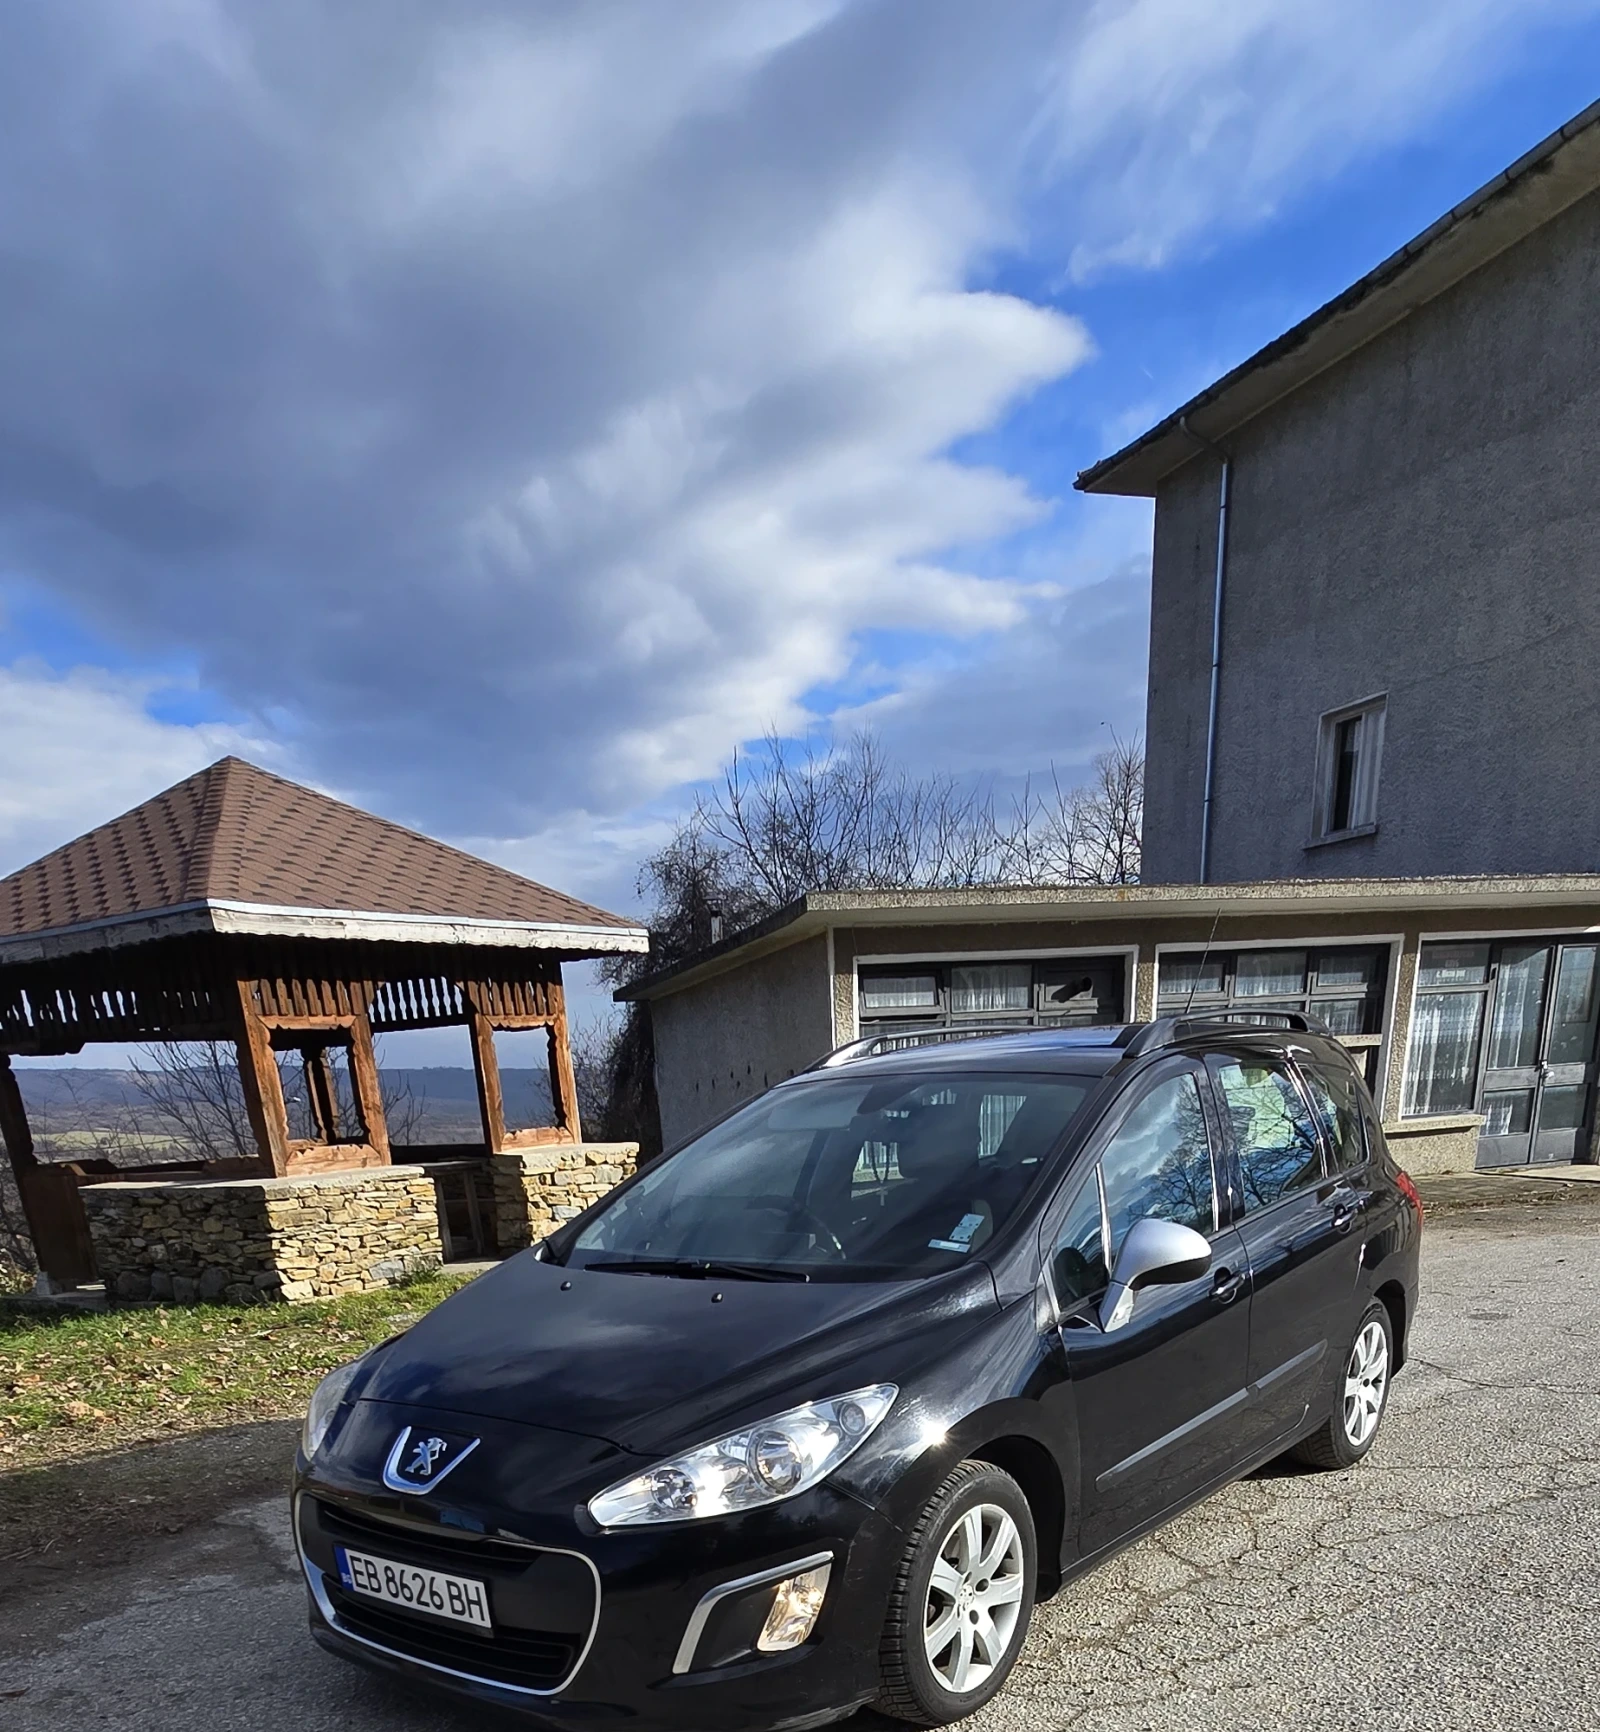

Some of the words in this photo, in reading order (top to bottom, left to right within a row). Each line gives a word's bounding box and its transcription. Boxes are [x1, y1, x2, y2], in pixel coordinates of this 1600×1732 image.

[349, 1554, 382, 1593] EB
[384, 1565, 445, 1611] 8626
[445, 1579, 486, 1622] BH
